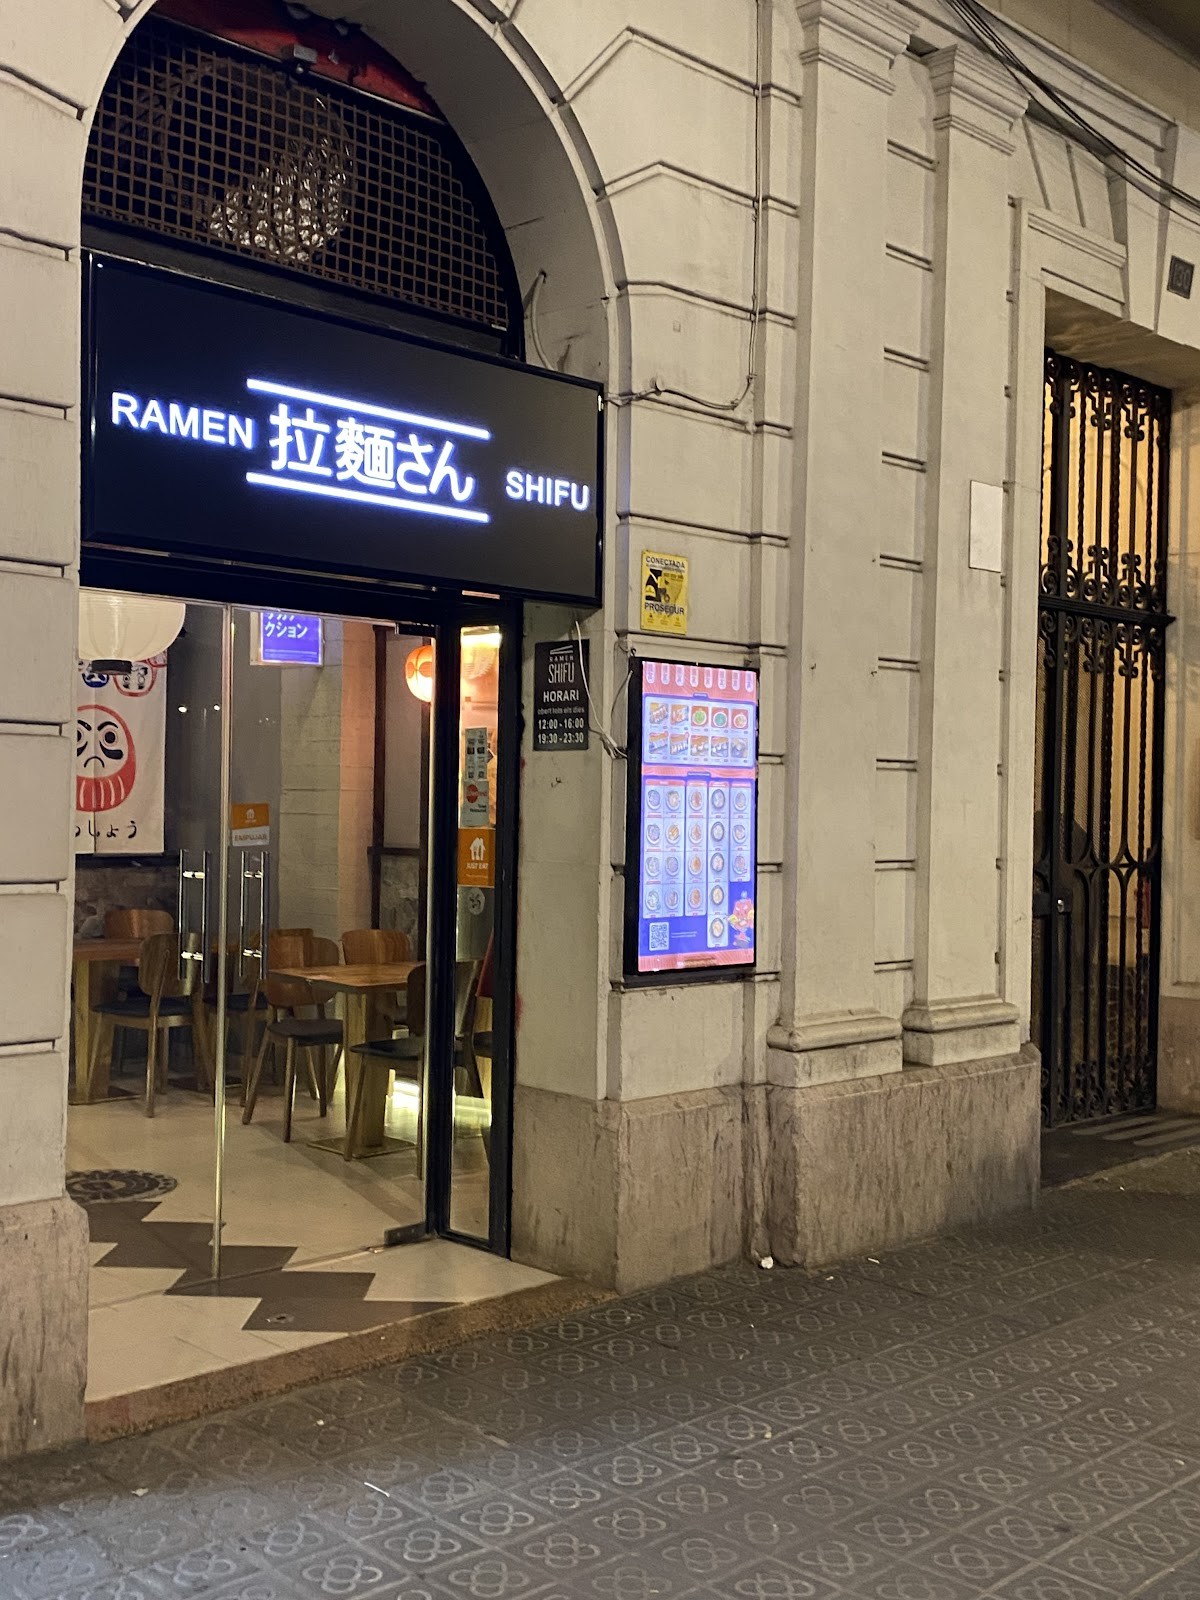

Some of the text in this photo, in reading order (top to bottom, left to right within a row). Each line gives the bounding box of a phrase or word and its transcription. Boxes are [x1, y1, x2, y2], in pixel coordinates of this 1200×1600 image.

[111, 391, 254, 450] RAMEN
[268, 402, 475, 502] 拉麵さん
[505, 470, 590, 511] SHIFU
[645, 556, 686, 569] CONECTADA
[644, 602, 685, 616] PROSEGUR
[264, 621, 308, 639] クション
[548, 662, 575, 684] SHIFU
[543, 689, 579, 703] HORARI
[538, 718, 558, 730] 12:00
[563, 718, 585, 730] 16:00
[538, 733, 558, 744] 19:30
[563, 732, 584, 744] 23:30
